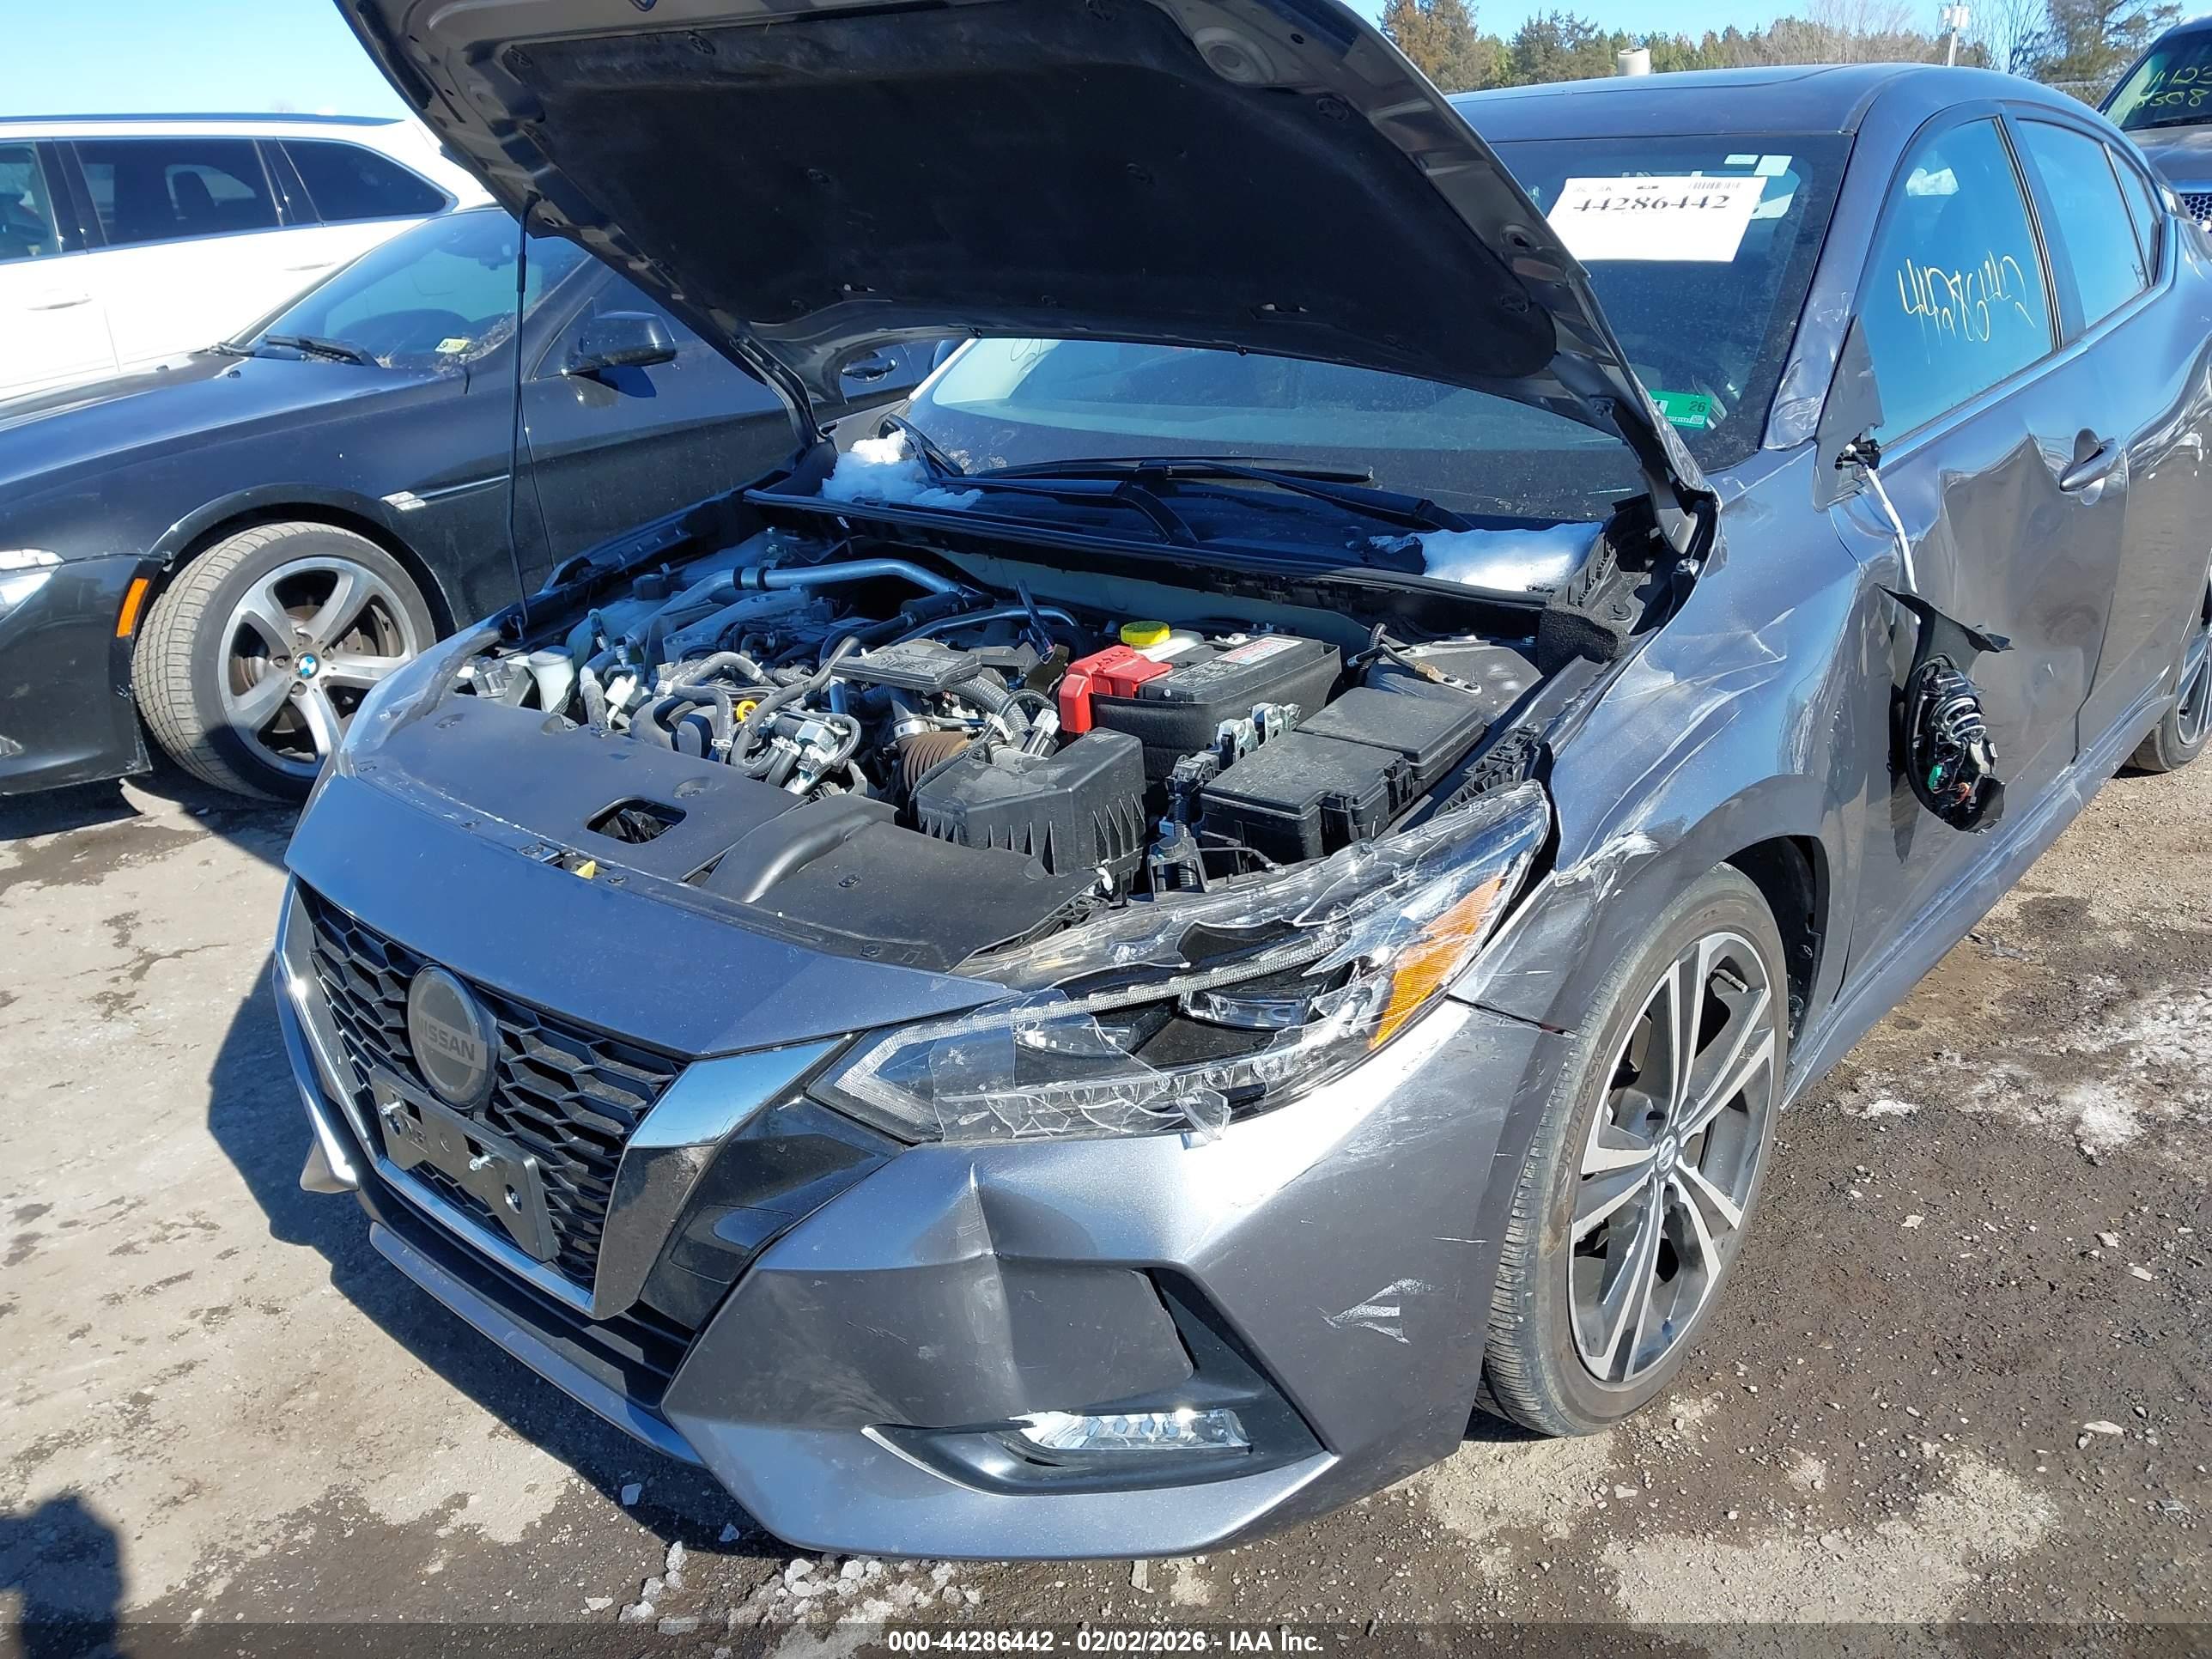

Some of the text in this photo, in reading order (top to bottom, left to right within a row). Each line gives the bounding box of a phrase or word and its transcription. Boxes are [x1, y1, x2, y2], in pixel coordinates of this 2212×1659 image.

[1573, 194, 1730, 212] 44286442
[1688, 400, 1707, 413] 26
[419, 1016, 476, 1062] NISSAN
